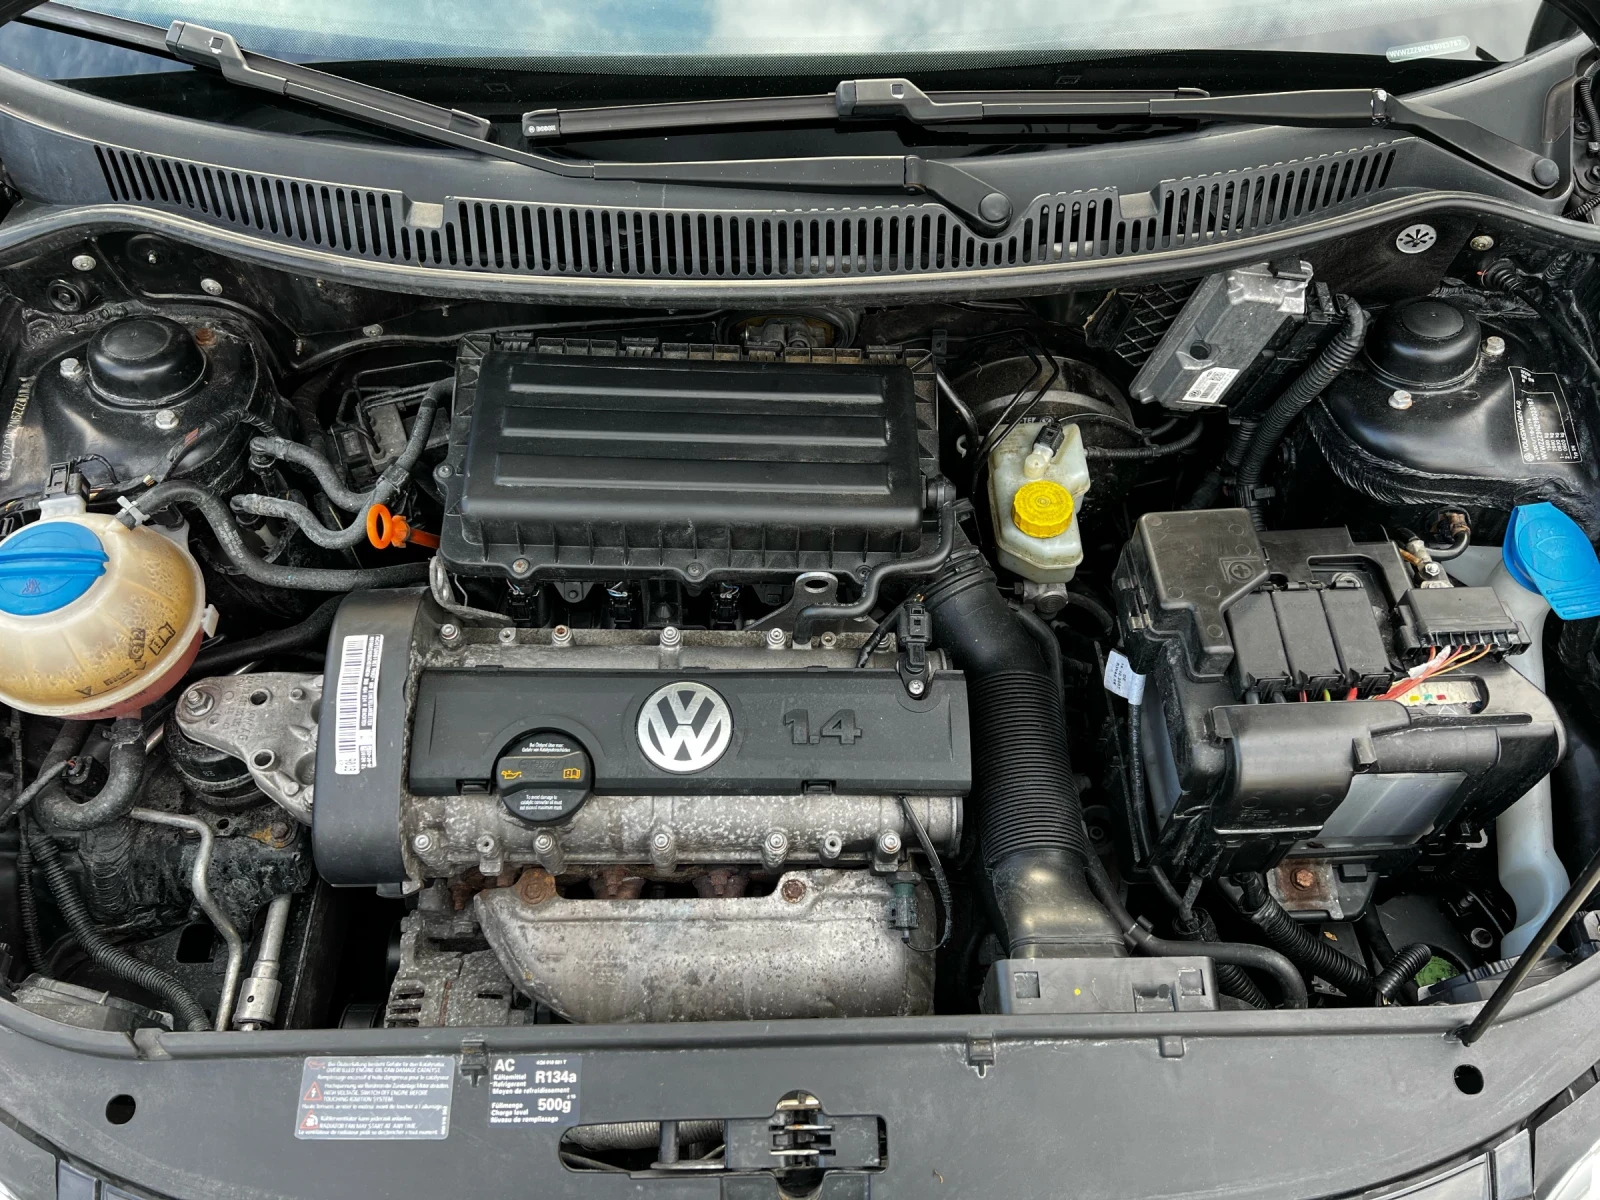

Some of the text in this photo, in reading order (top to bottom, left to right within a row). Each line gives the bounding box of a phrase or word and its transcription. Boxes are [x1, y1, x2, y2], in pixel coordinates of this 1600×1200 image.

[1516, 400, 1529, 452] VOLKSWAGEN AG
[782, 708, 862, 745] 1.4
[494, 1058, 516, 1072] AC
[535, 1070, 577, 1084] R134a
[537, 1098, 572, 1113] 500g
